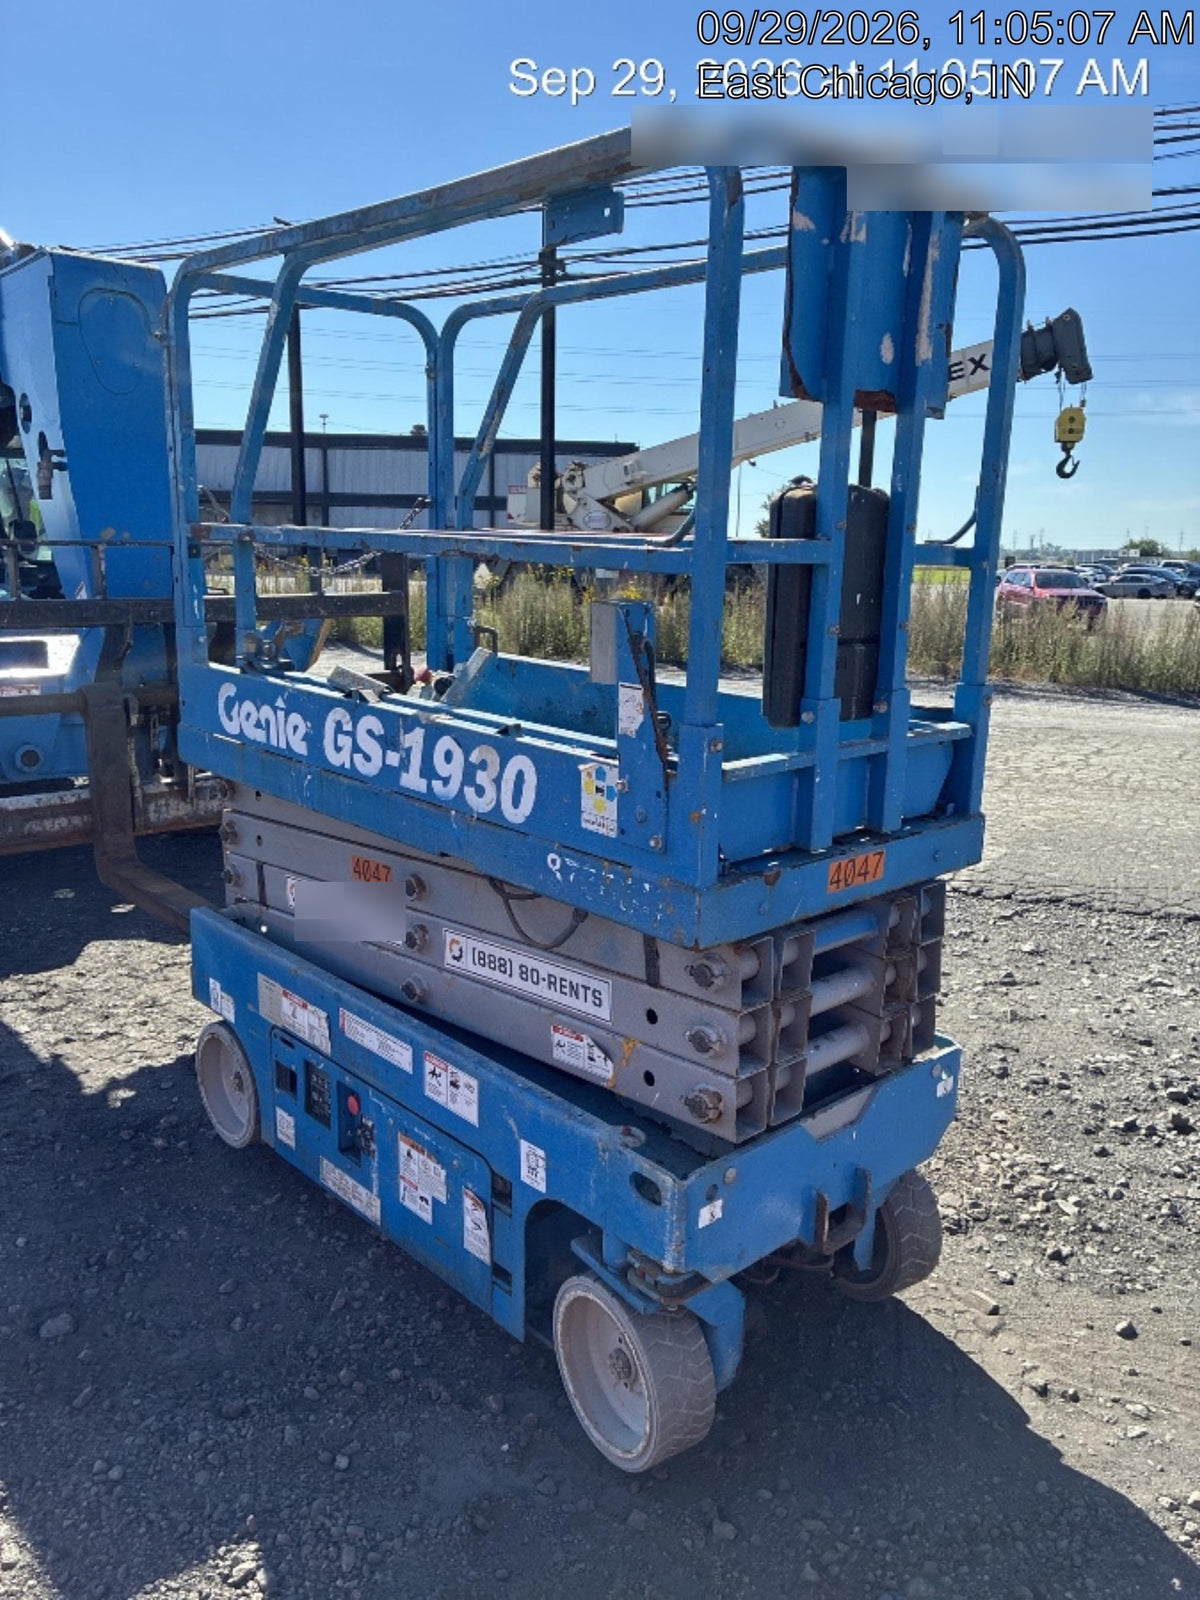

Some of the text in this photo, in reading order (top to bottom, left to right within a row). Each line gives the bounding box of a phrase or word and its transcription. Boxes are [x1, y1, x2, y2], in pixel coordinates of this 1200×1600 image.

[218, 682, 308, 756] Genie
[323, 707, 538, 824] GS-1930
[353, 857, 392, 882] 4047
[829, 851, 885, 889] 4047
[472, 947, 603, 1008] (888) 80-RENTS
